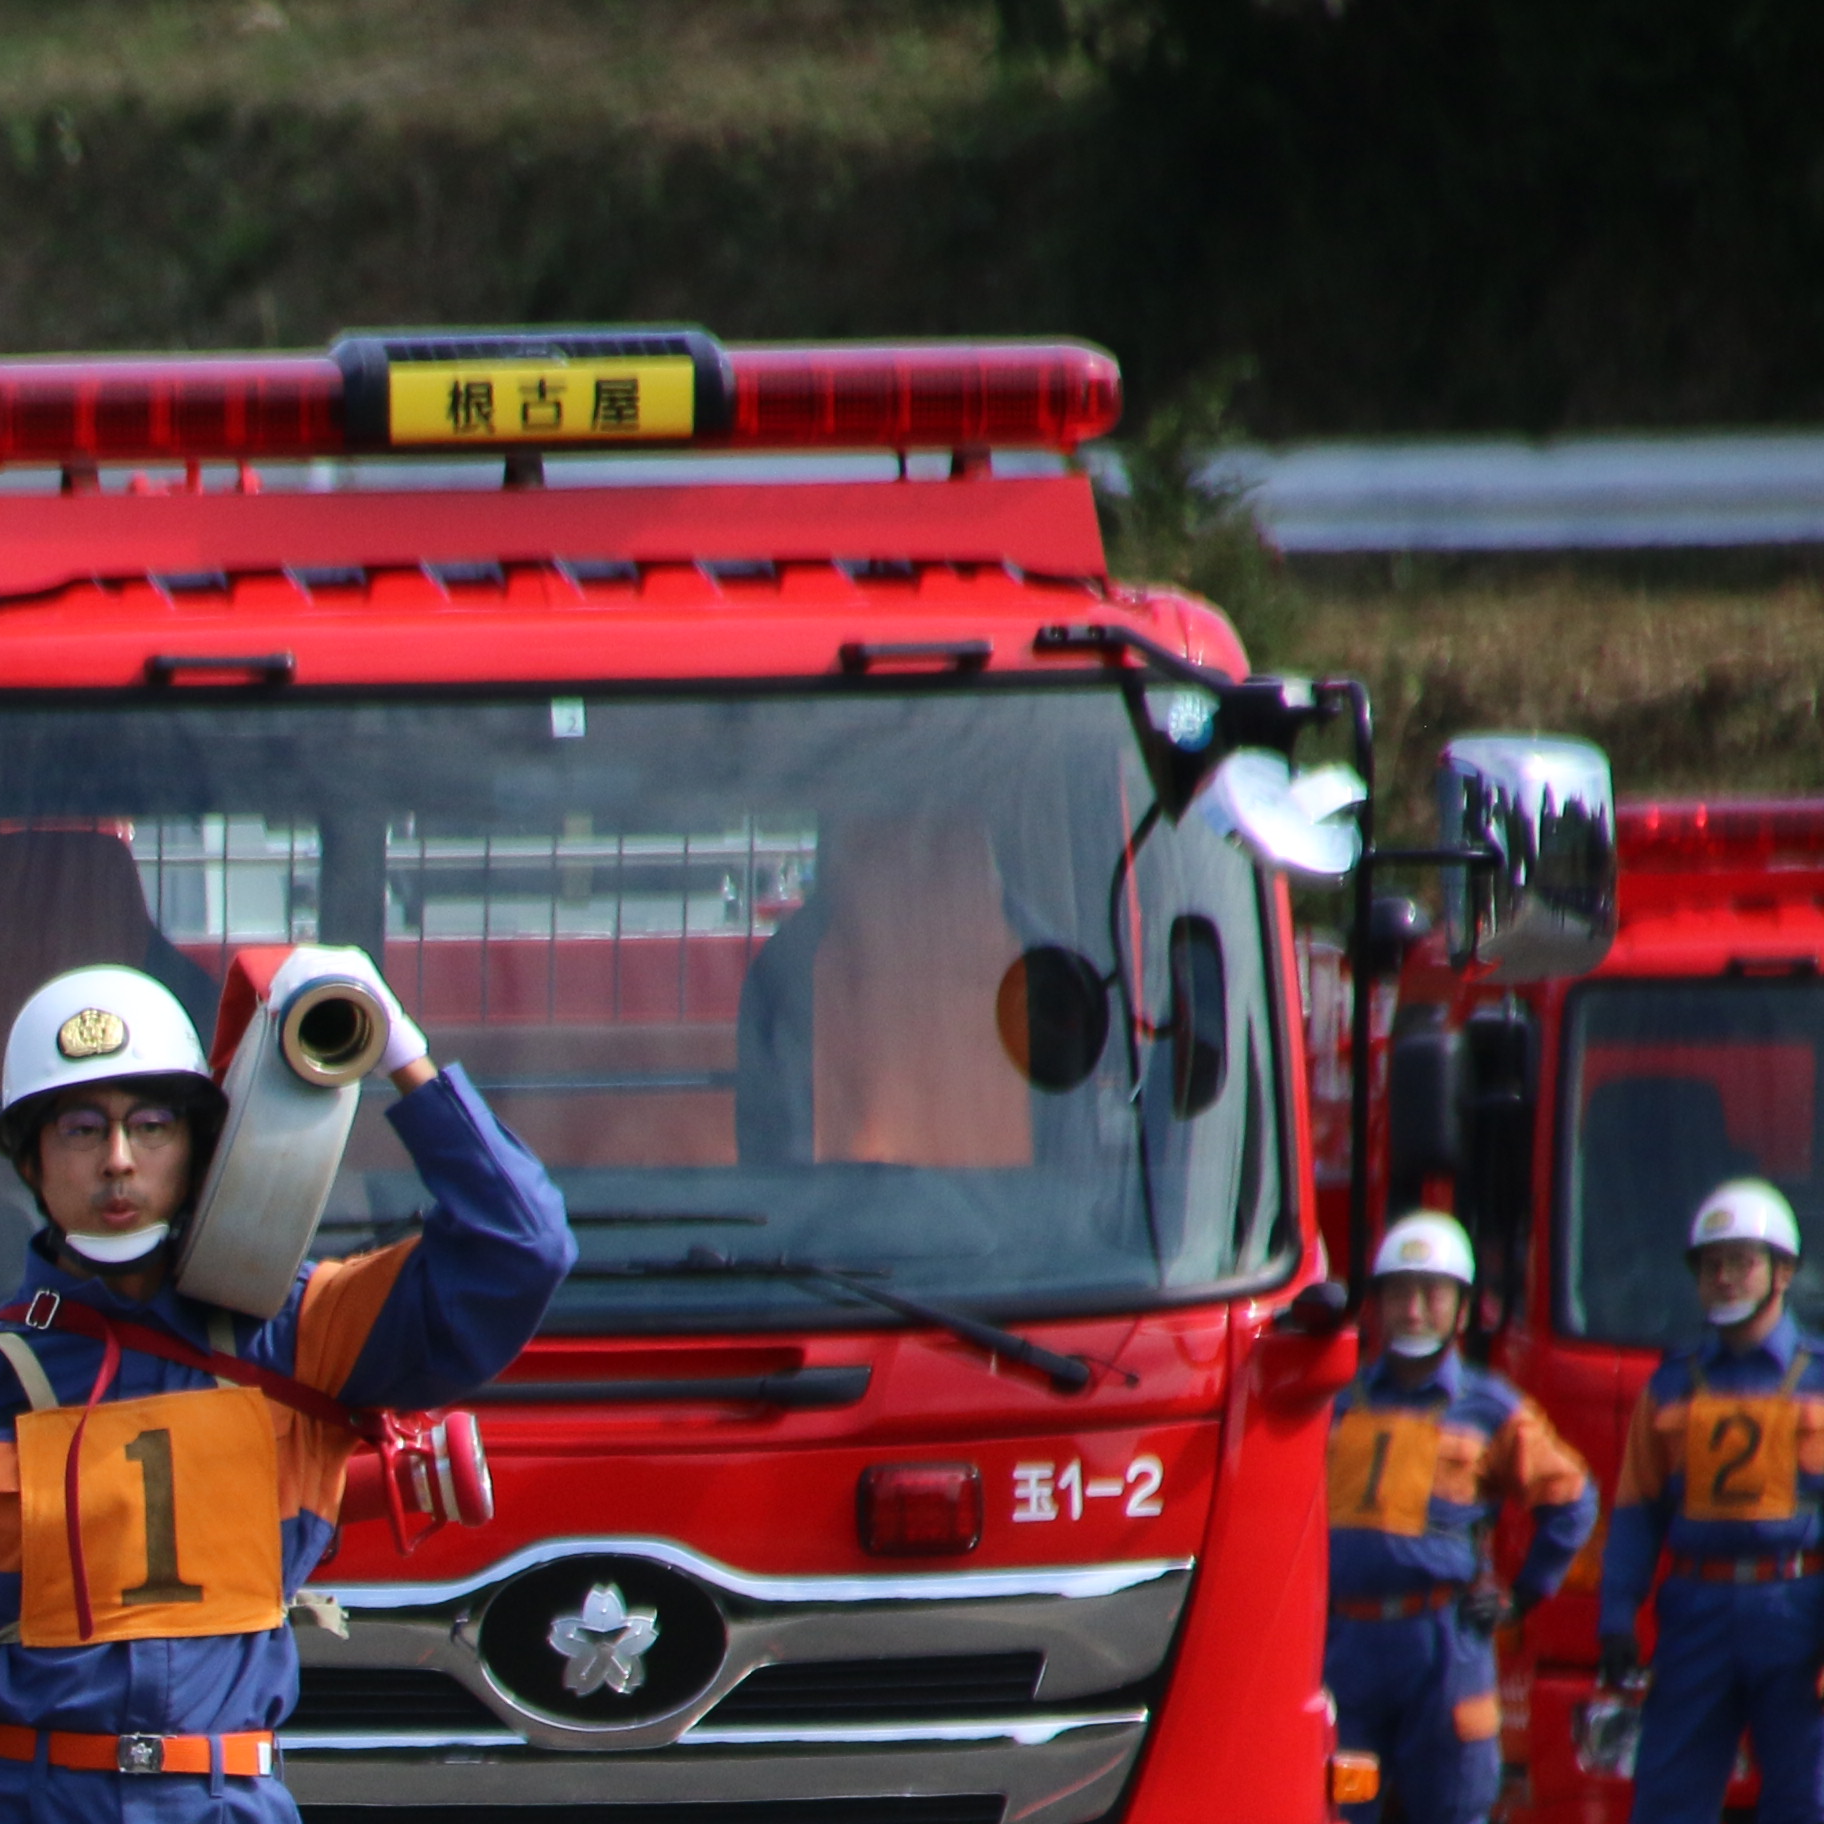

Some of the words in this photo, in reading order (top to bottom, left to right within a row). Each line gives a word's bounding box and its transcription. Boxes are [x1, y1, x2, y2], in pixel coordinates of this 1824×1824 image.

[447, 377, 640, 434] 根古屋
[1012, 1454, 1164, 1522] 玉1-2
[1354, 1430, 1392, 1513] 1
[1709, 1412, 1762, 1507] 2
[121, 1428, 204, 1606] 1
